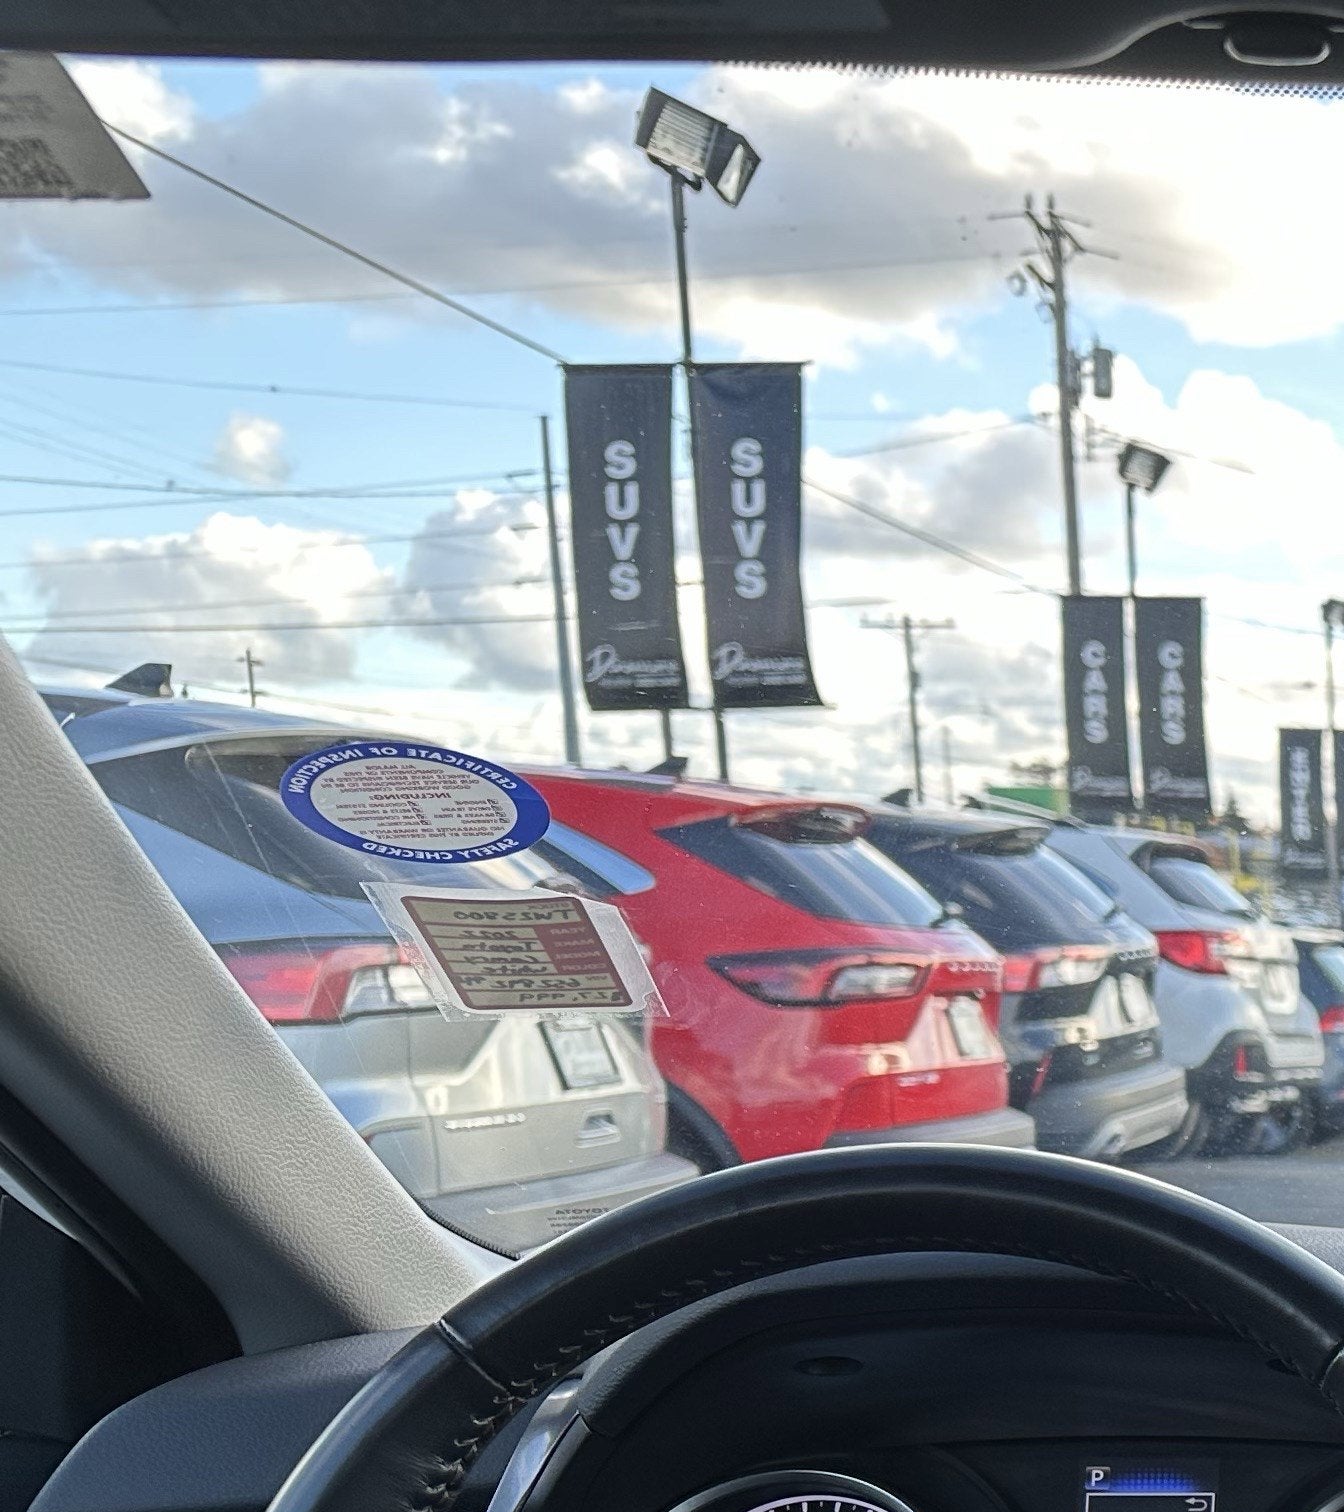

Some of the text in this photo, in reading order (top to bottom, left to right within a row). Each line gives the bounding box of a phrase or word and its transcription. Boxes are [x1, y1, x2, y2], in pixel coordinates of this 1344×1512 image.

[603, 440, 642, 602] SUVS
[729, 437, 767, 601] SUVS
[1080, 638, 1110, 744] CARS
[1157, 639, 1187, 745] CARS
[1089, 1469, 1104, 1487] P
